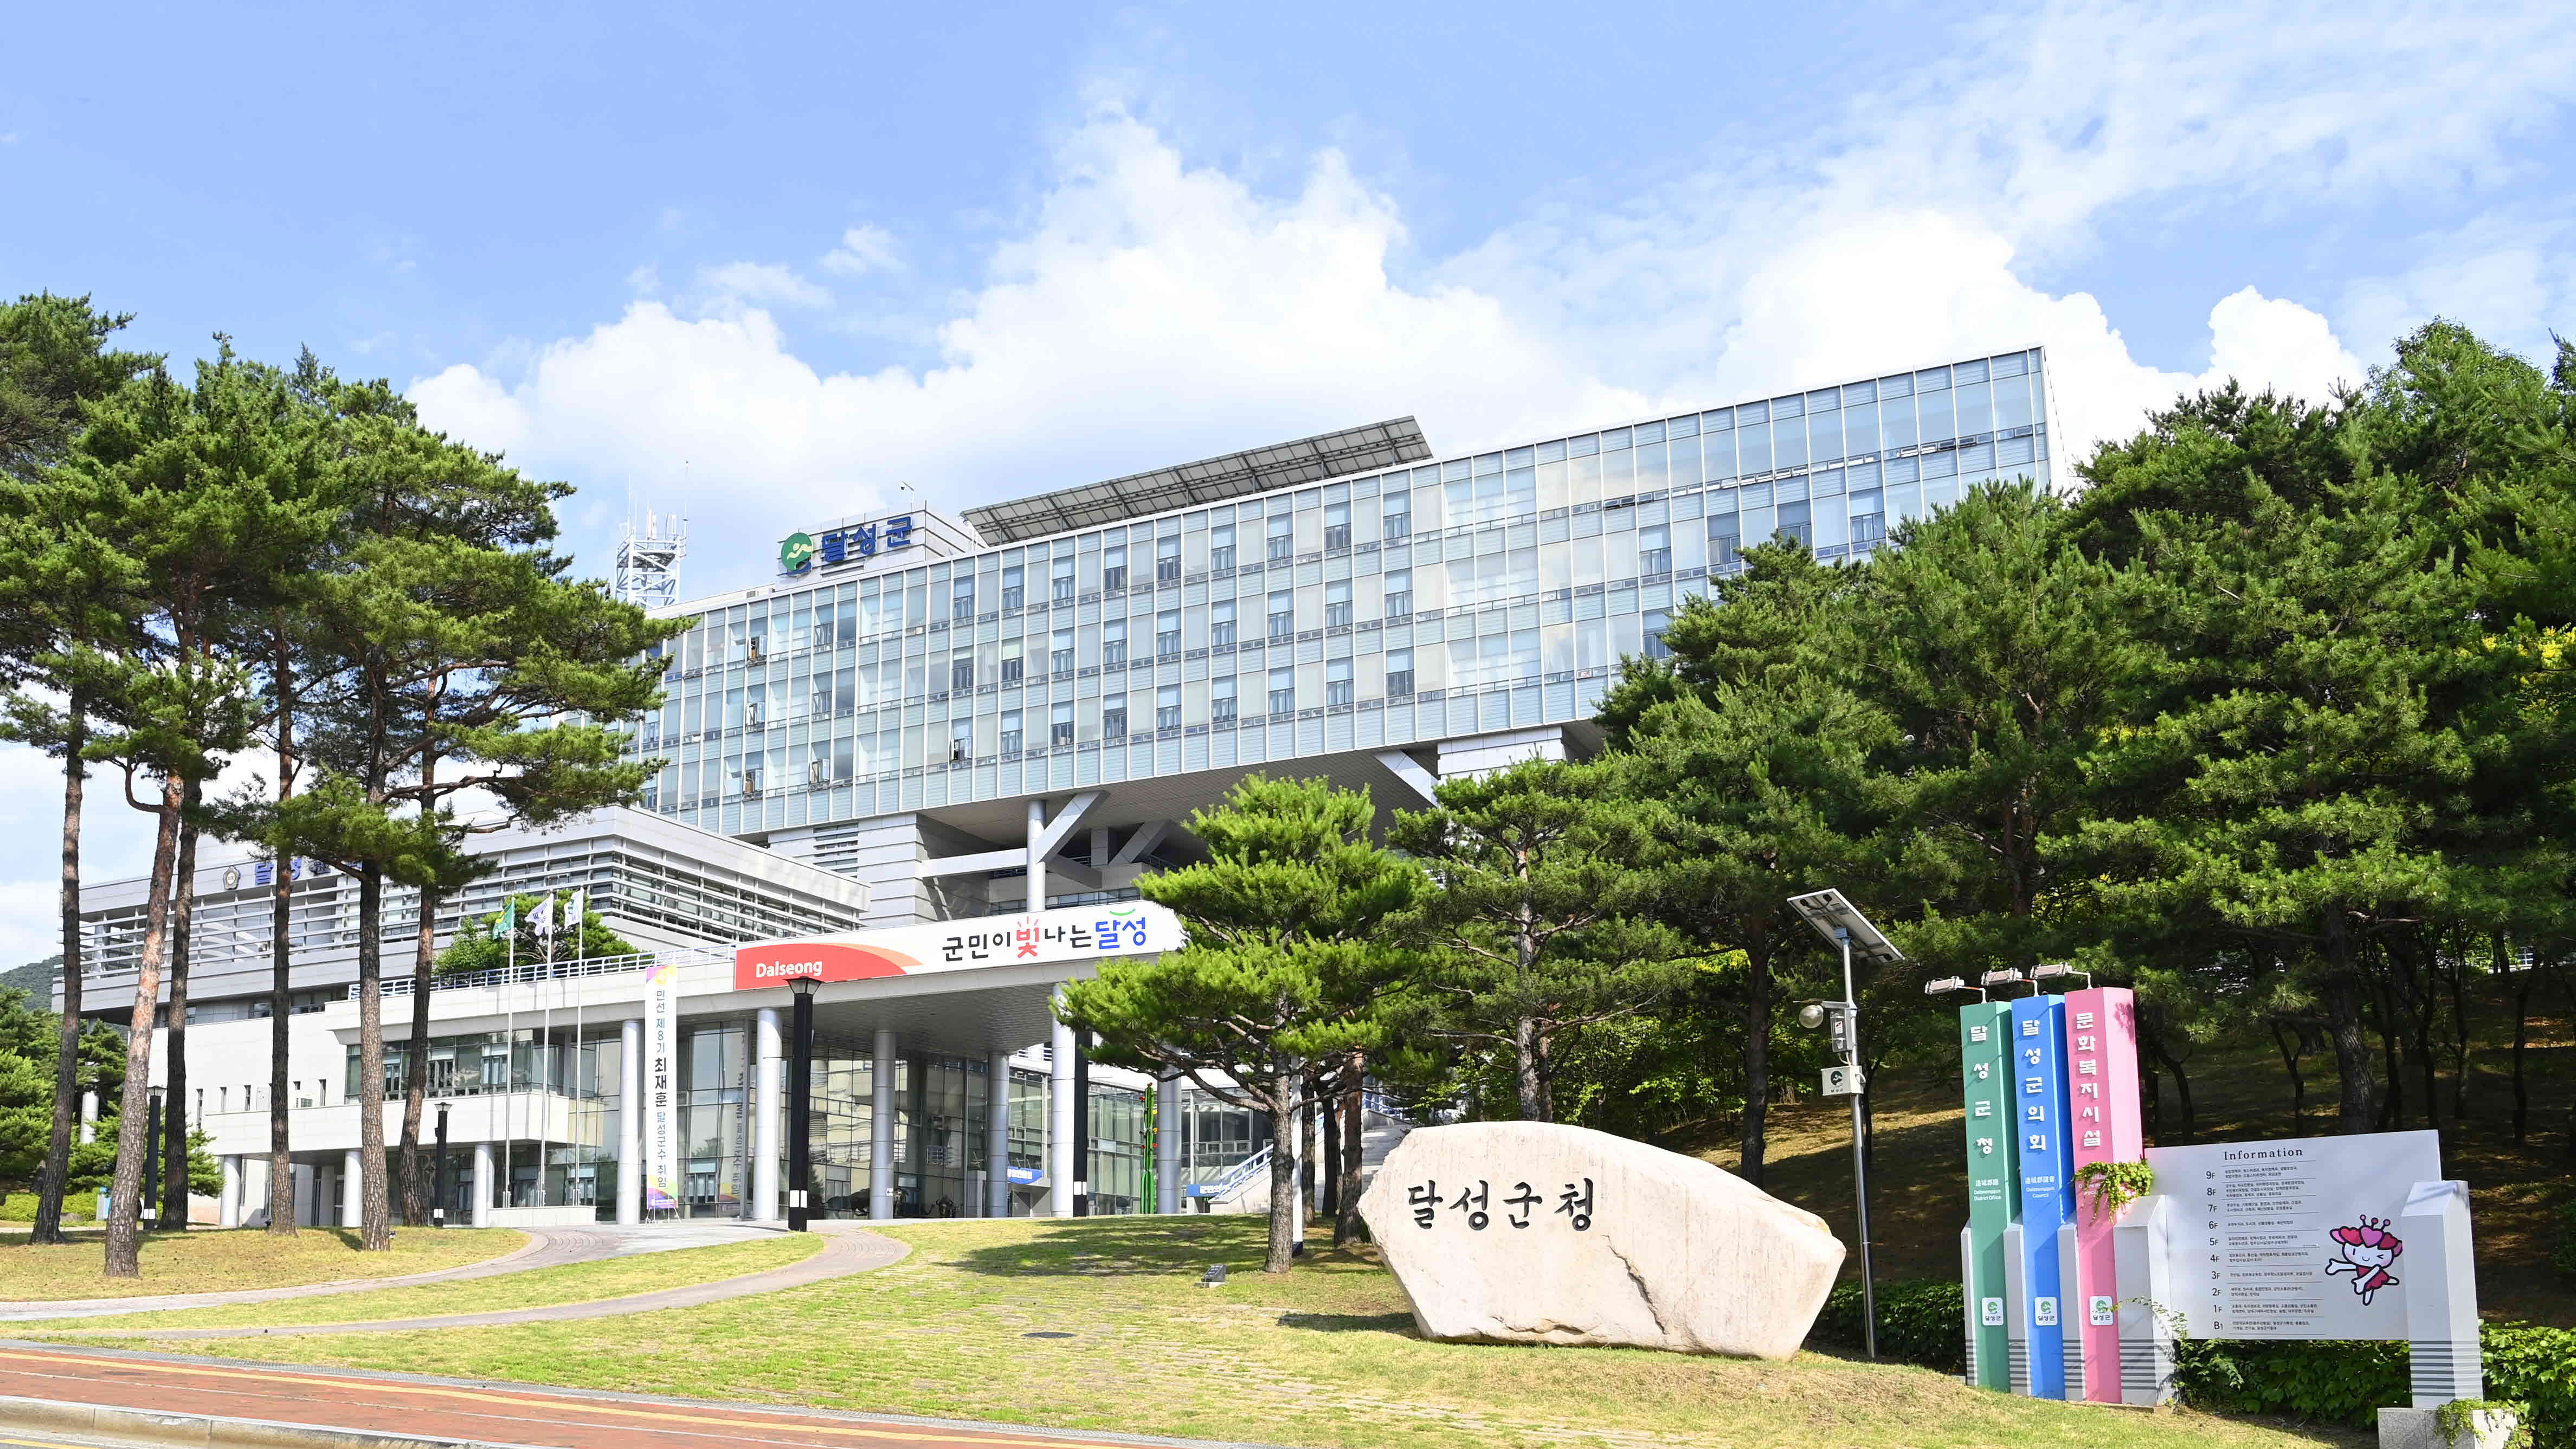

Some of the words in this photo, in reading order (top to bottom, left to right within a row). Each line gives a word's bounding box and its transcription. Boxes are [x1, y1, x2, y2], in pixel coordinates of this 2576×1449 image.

[821, 516, 913, 562] 달성군
[756, 961, 822, 978] Dalseong
[656, 990, 666, 1013] 민선
[654, 1057, 667, 1107] 최재훈
[2022, 1020, 2047, 1151] 달성군의회
[2076, 1012, 2101, 1147] 문화복지시설
[1969, 1025, 1993, 1155] 달성군청
[657, 1111, 666, 1160] 달성군수
[2224, 1148, 2303, 1161] Information
[658, 1164, 666, 1188] 취임
[2206, 1171, 2216, 1180] 9F
[2207, 1187, 2216, 1196] 8F
[1407, 1177, 1595, 1232] 달성군청
[2208, 1204, 2217, 1213] 7F
[2208, 1221, 2218, 1229] 6F
[2210, 1237, 2219, 1246] 5F
[2210, 1254, 2220, 1263] 4F
[2211, 1271, 2220, 1279] 3F
[2212, 1287, 2221, 1296] 2F
[2213, 1304, 2223, 1313] 1F
[2214, 1321, 2223, 1330] B1
